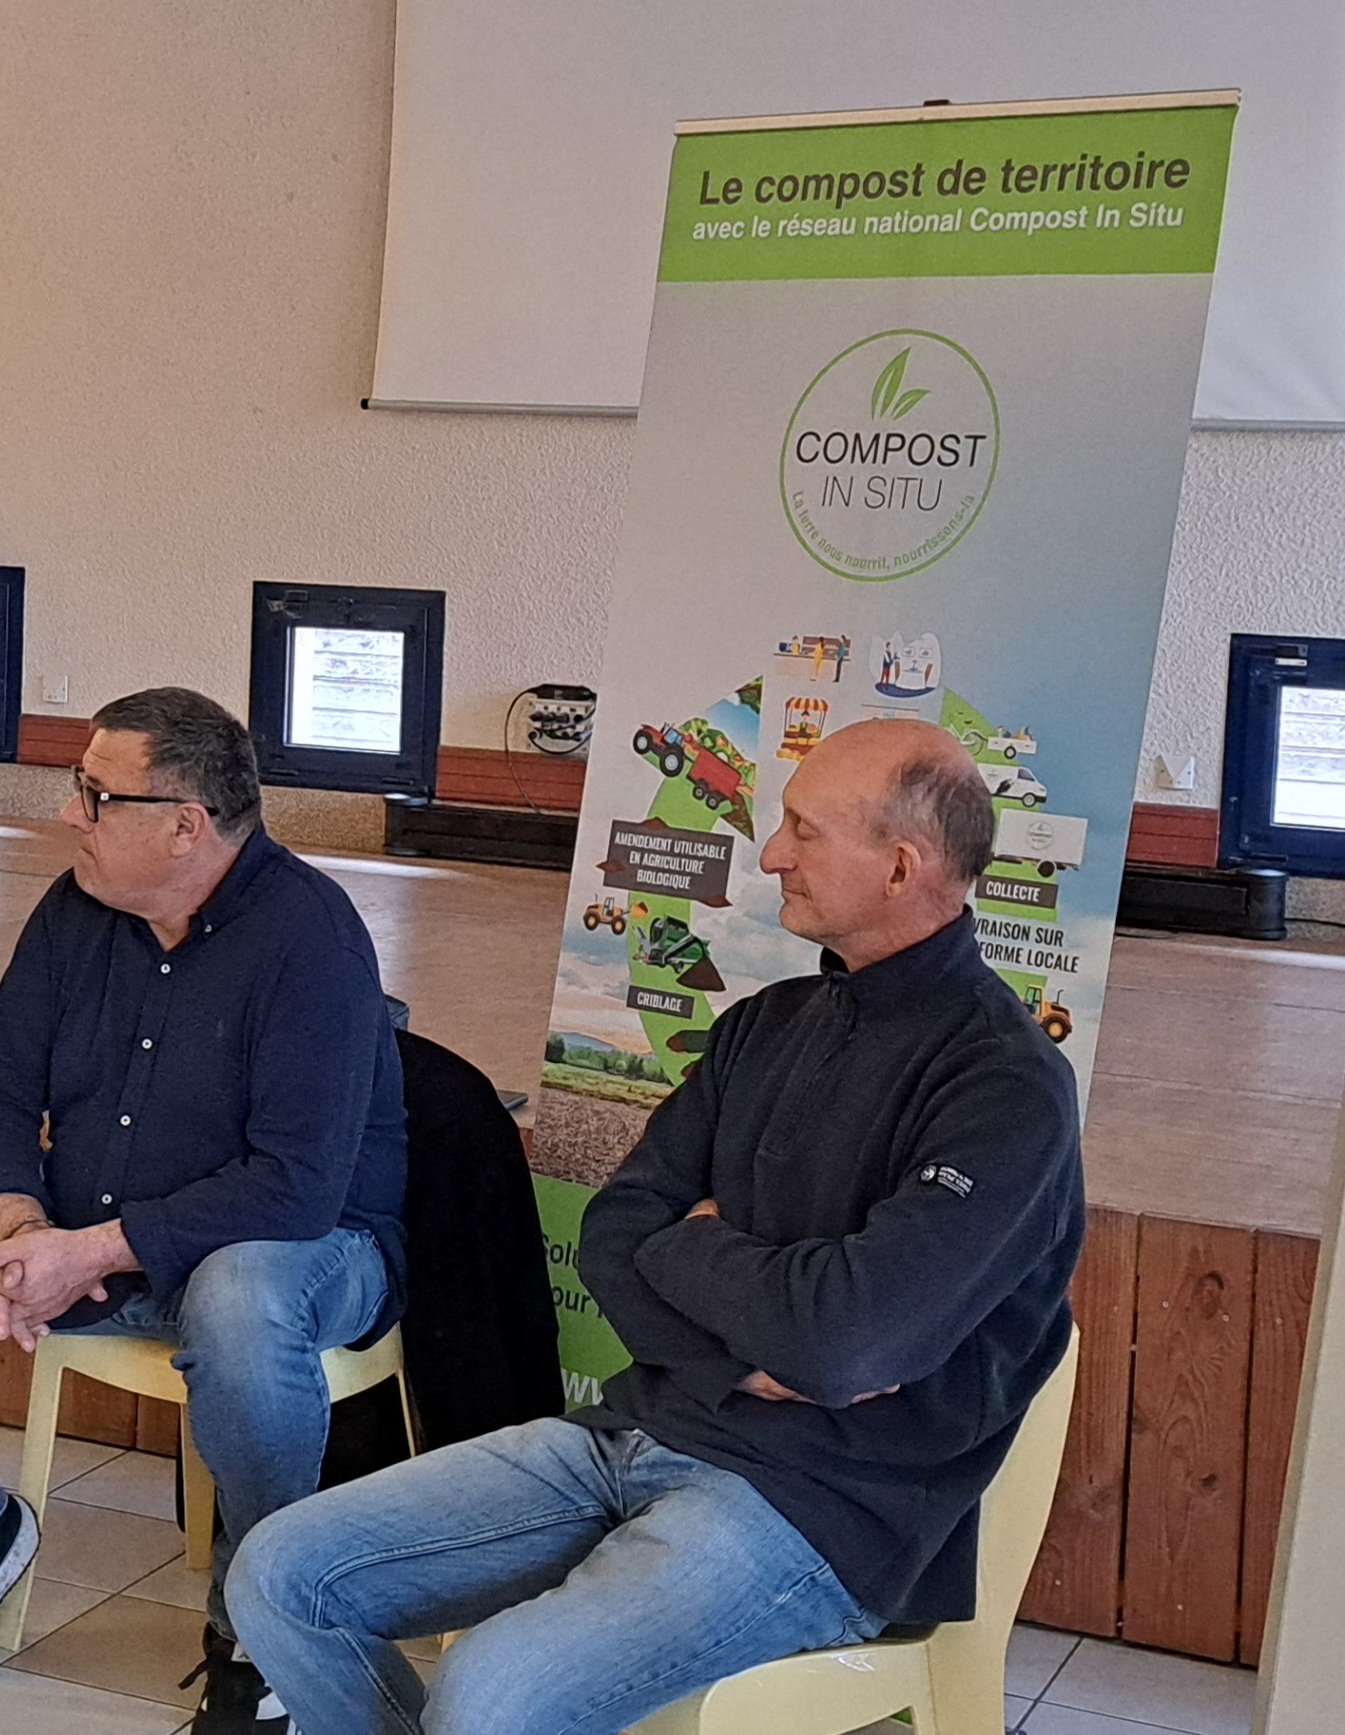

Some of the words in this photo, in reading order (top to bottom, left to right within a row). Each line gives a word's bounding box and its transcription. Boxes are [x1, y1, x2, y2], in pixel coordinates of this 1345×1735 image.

[699, 170, 743, 206] Le
[755, 163, 925, 210] compost
[937, 158, 987, 196] de
[1000, 151, 1191, 194] territoire
[692, 220, 745, 240] avec
[751, 215, 771, 238] le
[777, 213, 856, 238] réseau
[863, 208, 962, 235] national
[970, 205, 1088, 236] Compost
[1096, 204, 1120, 228] In
[1129, 202, 1184, 228] Situ
[796, 431, 987, 467] COMPOST
[821, 475, 854, 508] IN
[864, 475, 943, 511] SITU
[798, 509, 819, 540] terre
[817, 537, 843, 562] nous
[614, 831, 672, 852] AMENDEMENT
[673, 840, 726, 860] UTILISABLE
[629, 851, 641, 865] EN
[642, 853, 705, 874] AGRICULTURE
[636, 869, 691, 890] BIOLOGIQUE
[986, 881, 1041, 902] COLLECTE
[1035, 927, 1064, 948] SUR
[1027, 949, 1080, 973] LOCALE
[637, 992, 683, 1012] CRIBLAGE
